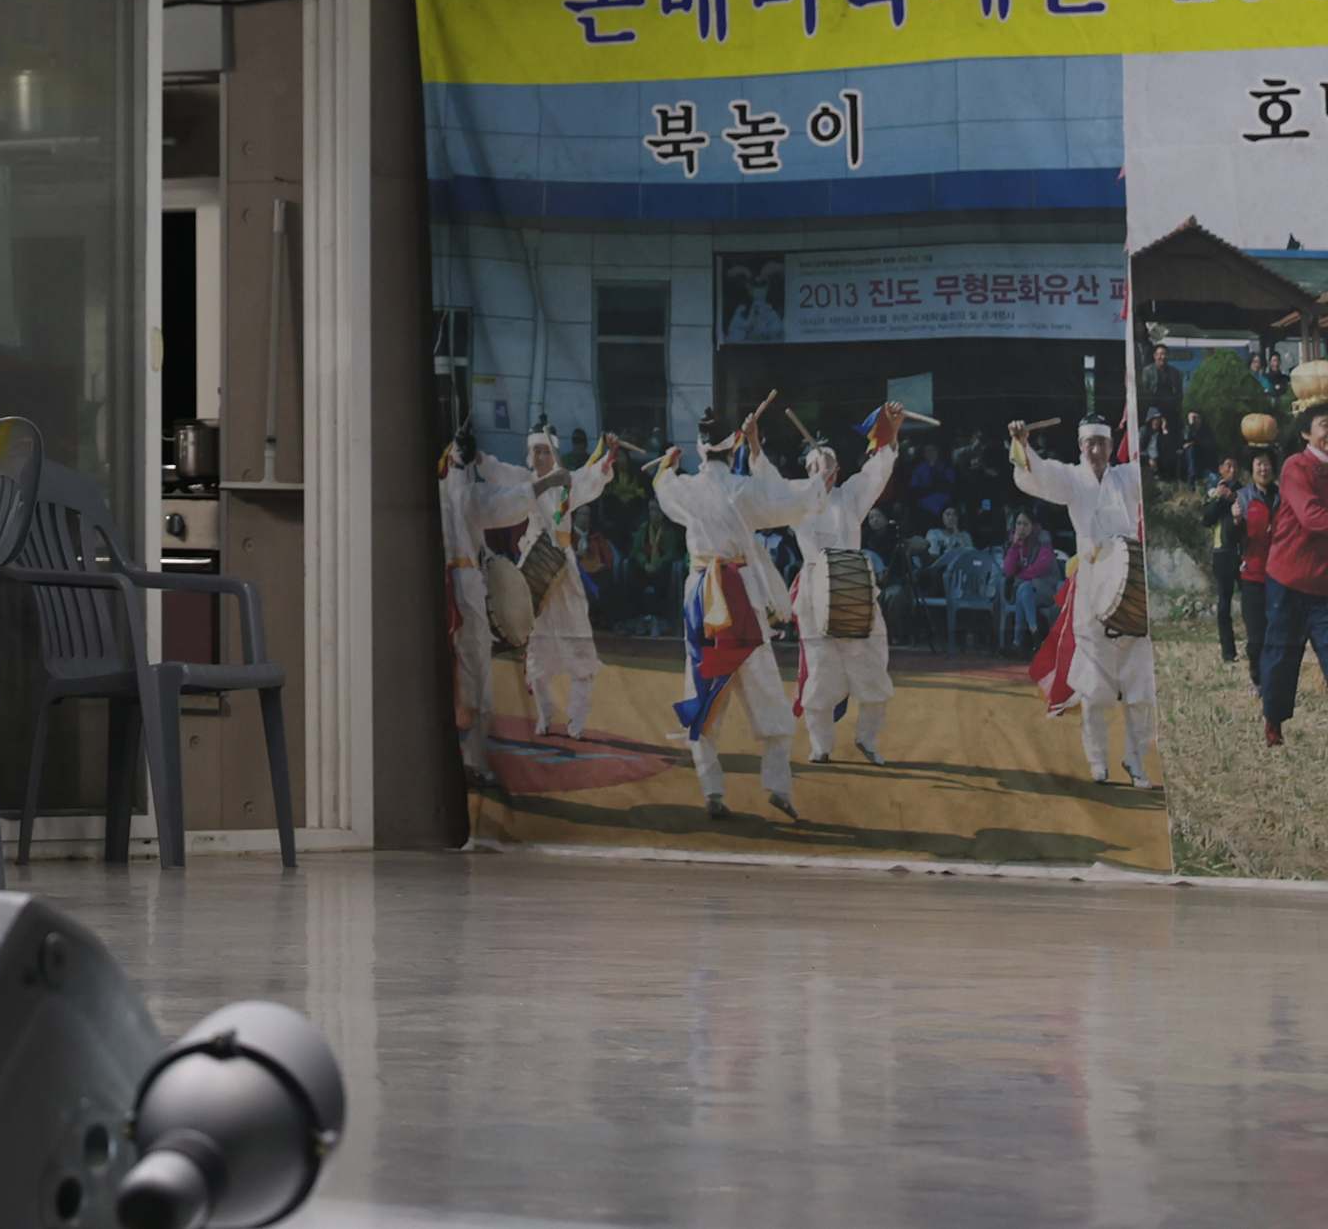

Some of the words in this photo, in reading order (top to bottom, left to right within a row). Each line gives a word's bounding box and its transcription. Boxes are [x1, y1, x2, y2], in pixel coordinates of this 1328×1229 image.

[643, 89, 863, 178] 북놀이
[1242, 78, 1328, 144] 호
[799, 283, 858, 308] 2013
[868, 278, 922, 307] 진도
[933, 274, 1099, 305] 무형문화유산
